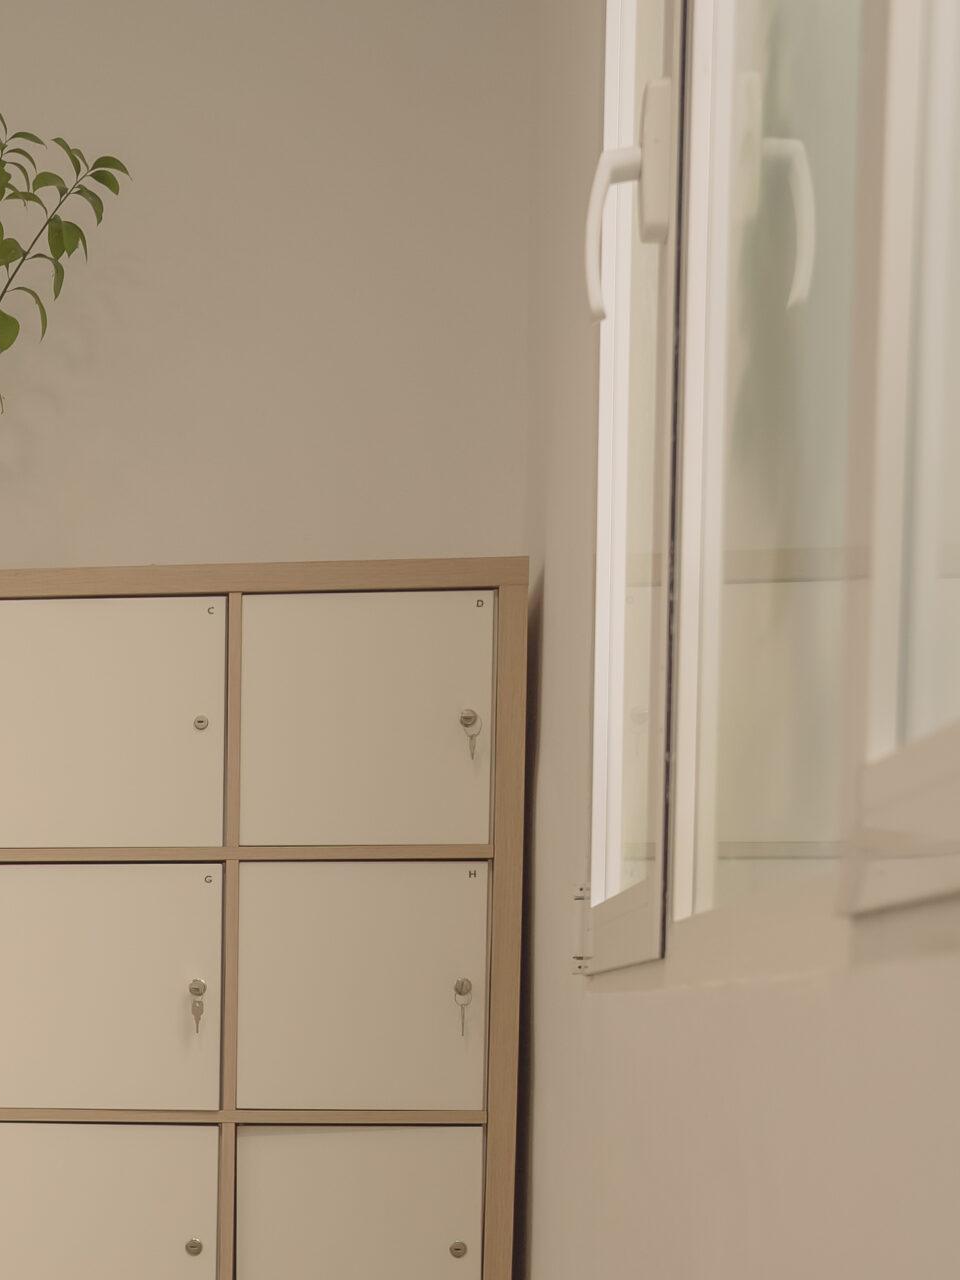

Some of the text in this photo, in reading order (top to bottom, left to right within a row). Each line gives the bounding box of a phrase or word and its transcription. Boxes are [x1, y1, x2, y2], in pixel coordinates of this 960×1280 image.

[476, 600, 484, 608] D
[207, 607, 215, 615] C
[468, 870, 477, 878] H
[204, 875, 213, 883] G
